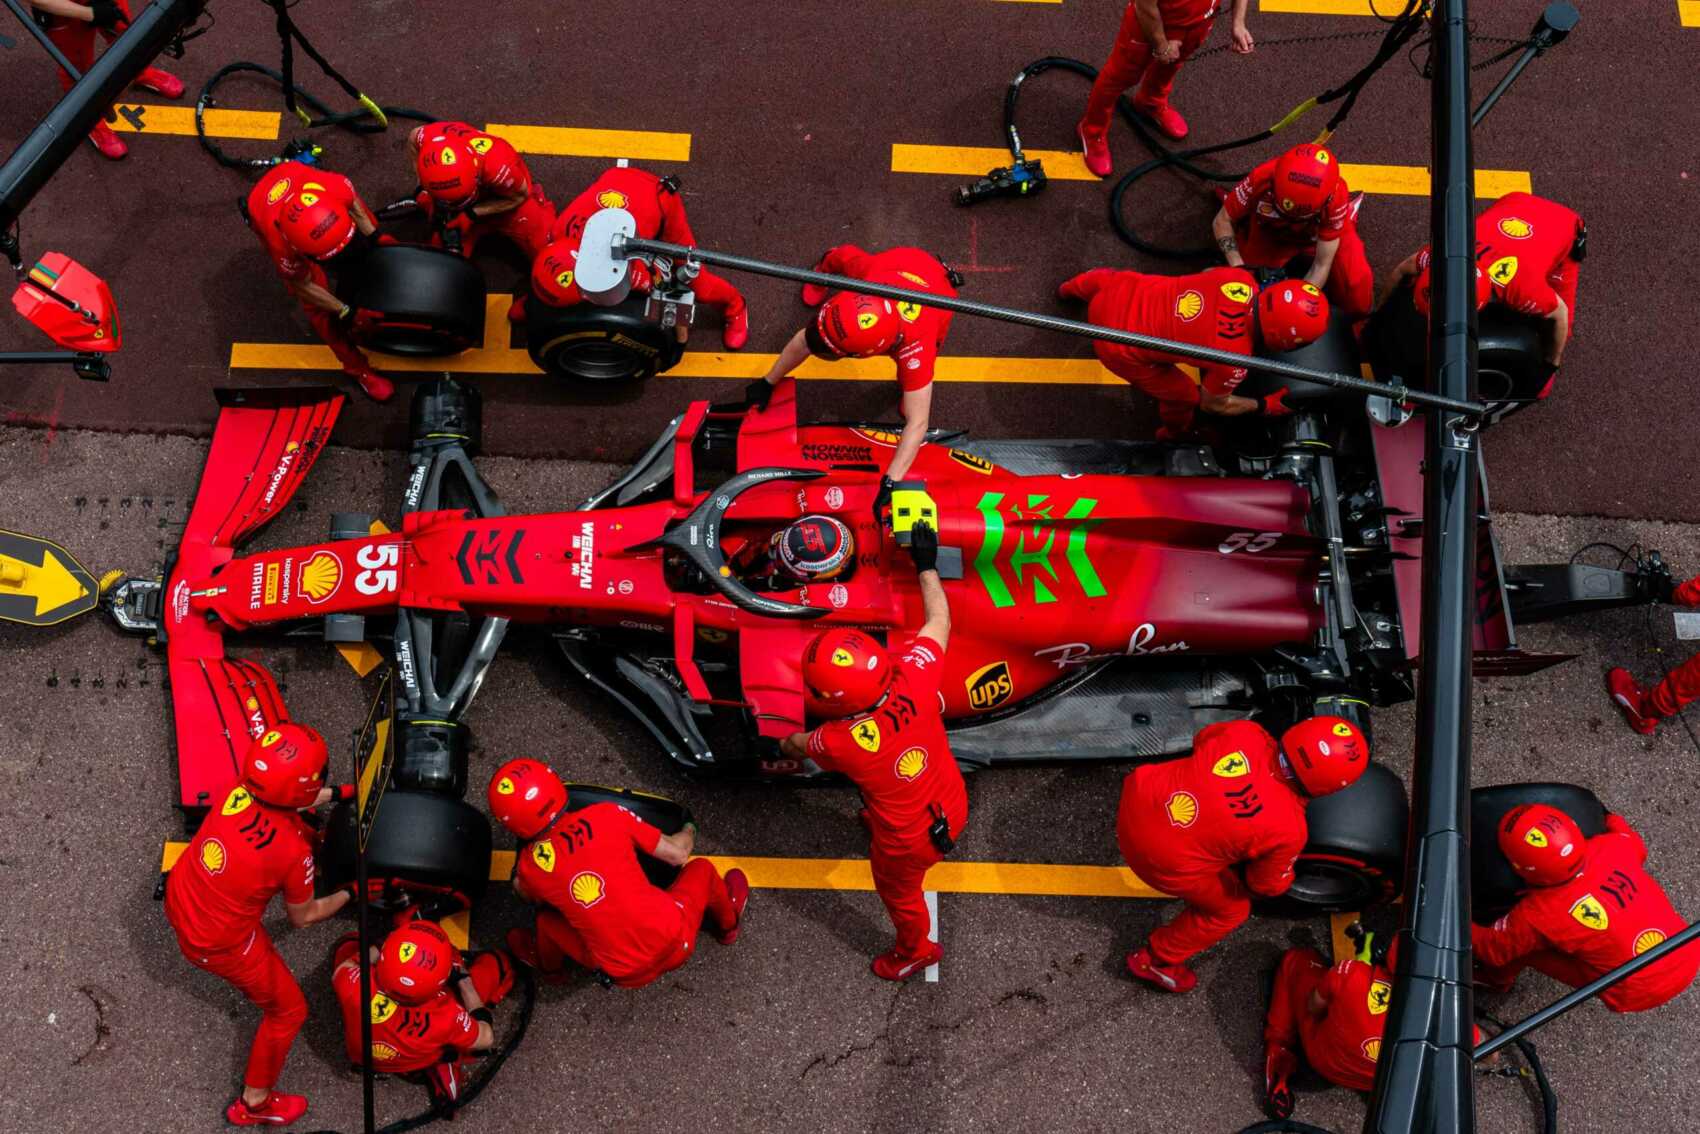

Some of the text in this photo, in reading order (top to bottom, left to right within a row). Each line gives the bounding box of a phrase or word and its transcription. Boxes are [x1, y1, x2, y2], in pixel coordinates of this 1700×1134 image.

[264, 455, 293, 504] V-Power
[407, 465, 426, 506] WEICHAI
[580, 522, 594, 590] WEICHAI
[1218, 532, 1283, 554] 55
[250, 562, 264, 609] MAHLE
[354, 544, 399, 595] 55
[400, 640, 416, 688] WEICHAI
